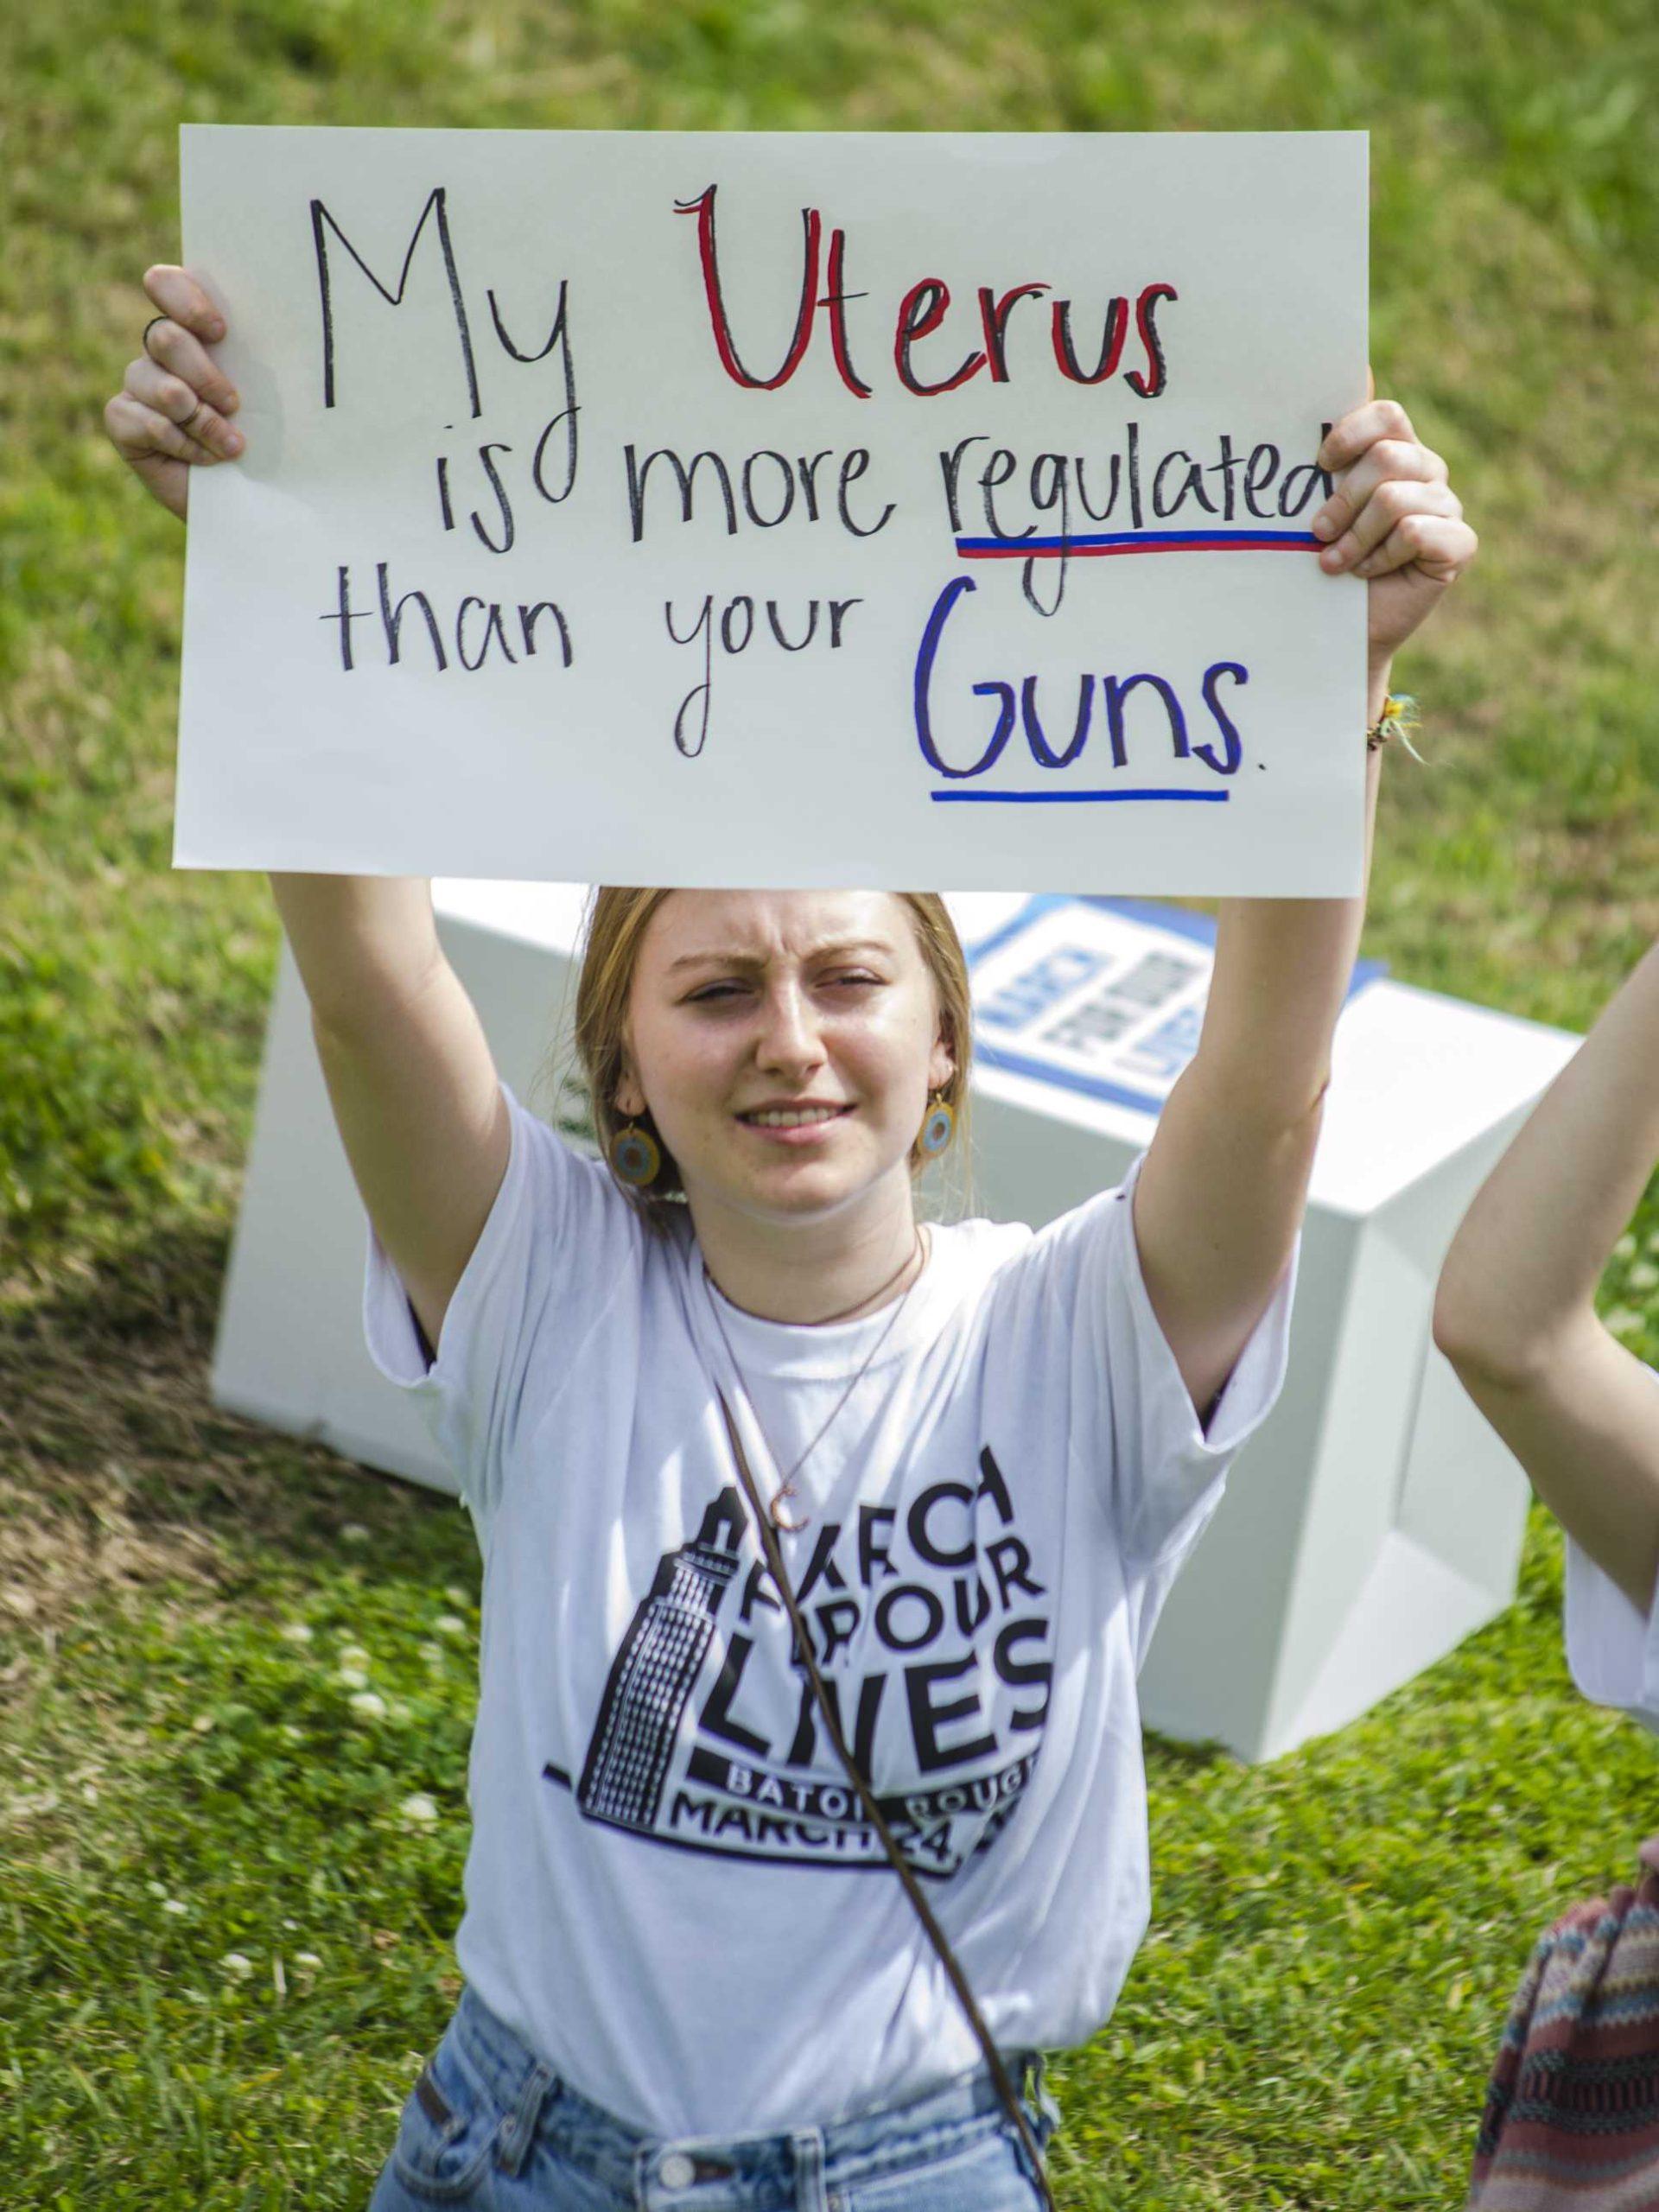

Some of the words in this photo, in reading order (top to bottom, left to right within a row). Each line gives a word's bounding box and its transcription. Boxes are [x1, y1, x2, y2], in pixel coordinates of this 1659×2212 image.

[310, 187, 582, 503] My
[673, 183, 1179, 399] Uterus
[436, 424, 514, 554] is
[624, 443, 897, 543] more
[939, 422, 1335, 616] regulated
[320, 563, 573, 671] than
[665, 594, 864, 758] your
[913, 575, 1267, 779] Guns.
[874, 1535, 1048, 1653] OUR
[698, 1618, 1052, 1776] LIVES
